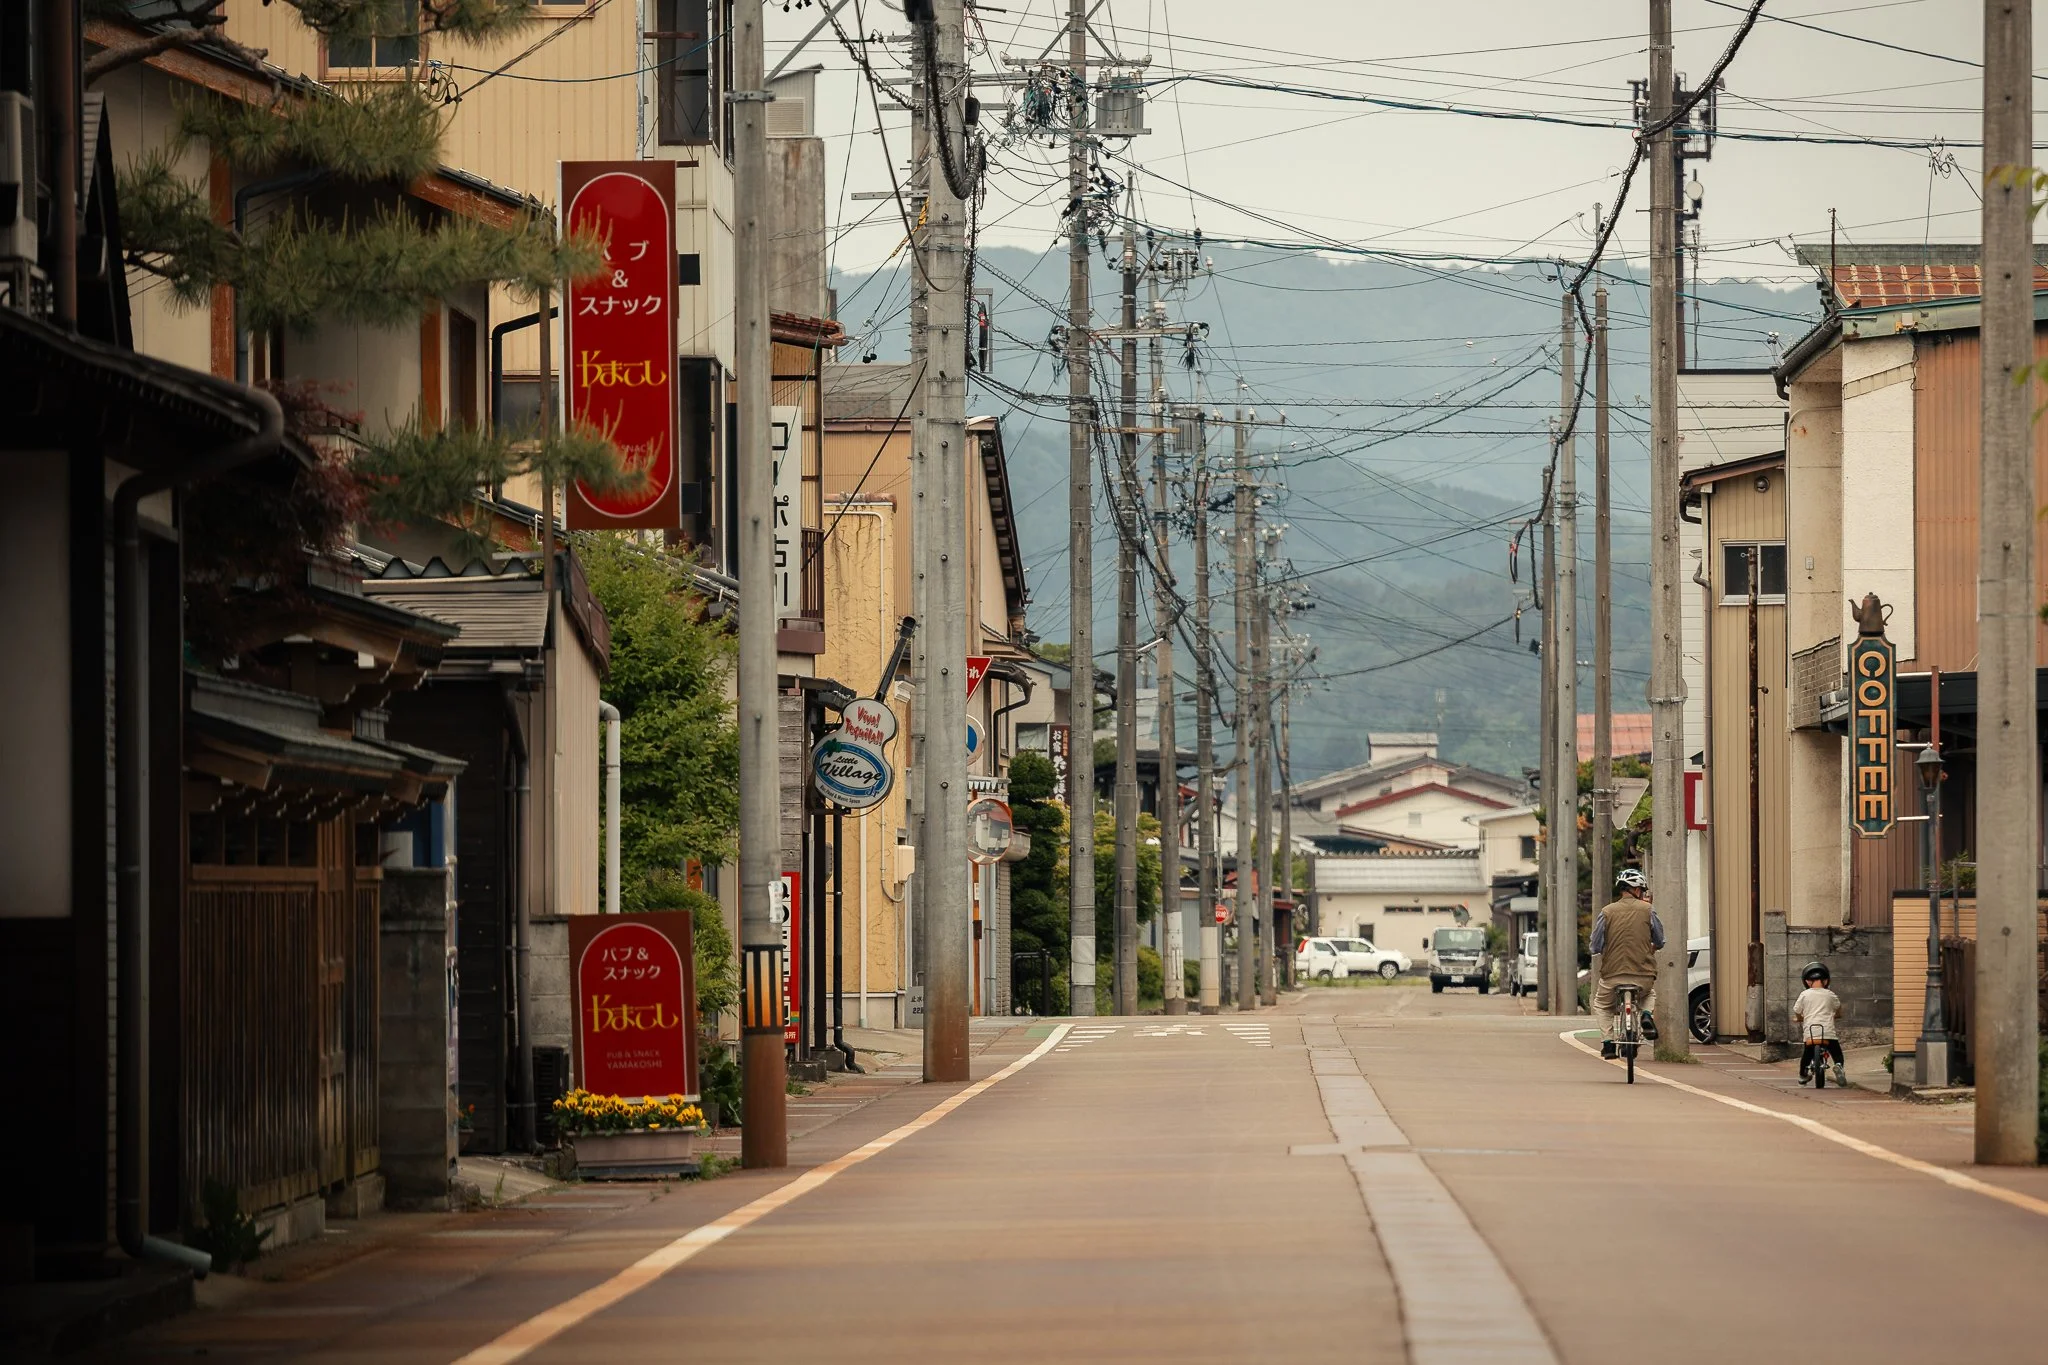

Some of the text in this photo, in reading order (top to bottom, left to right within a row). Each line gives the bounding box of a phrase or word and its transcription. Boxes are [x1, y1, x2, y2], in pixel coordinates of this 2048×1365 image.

[611, 269, 630, 289] &
[578, 295, 662, 316] スナック
[576, 350, 667, 388] やまこし
[1858, 651, 1888, 821] COFFEE
[833, 755, 859, 765] Little
[819, 762, 883, 785] Village
[603, 965, 661, 980] スナック
[587, 994, 679, 1032] やまこし
[607, 1060, 663, 1069] YAMAKOSHI
